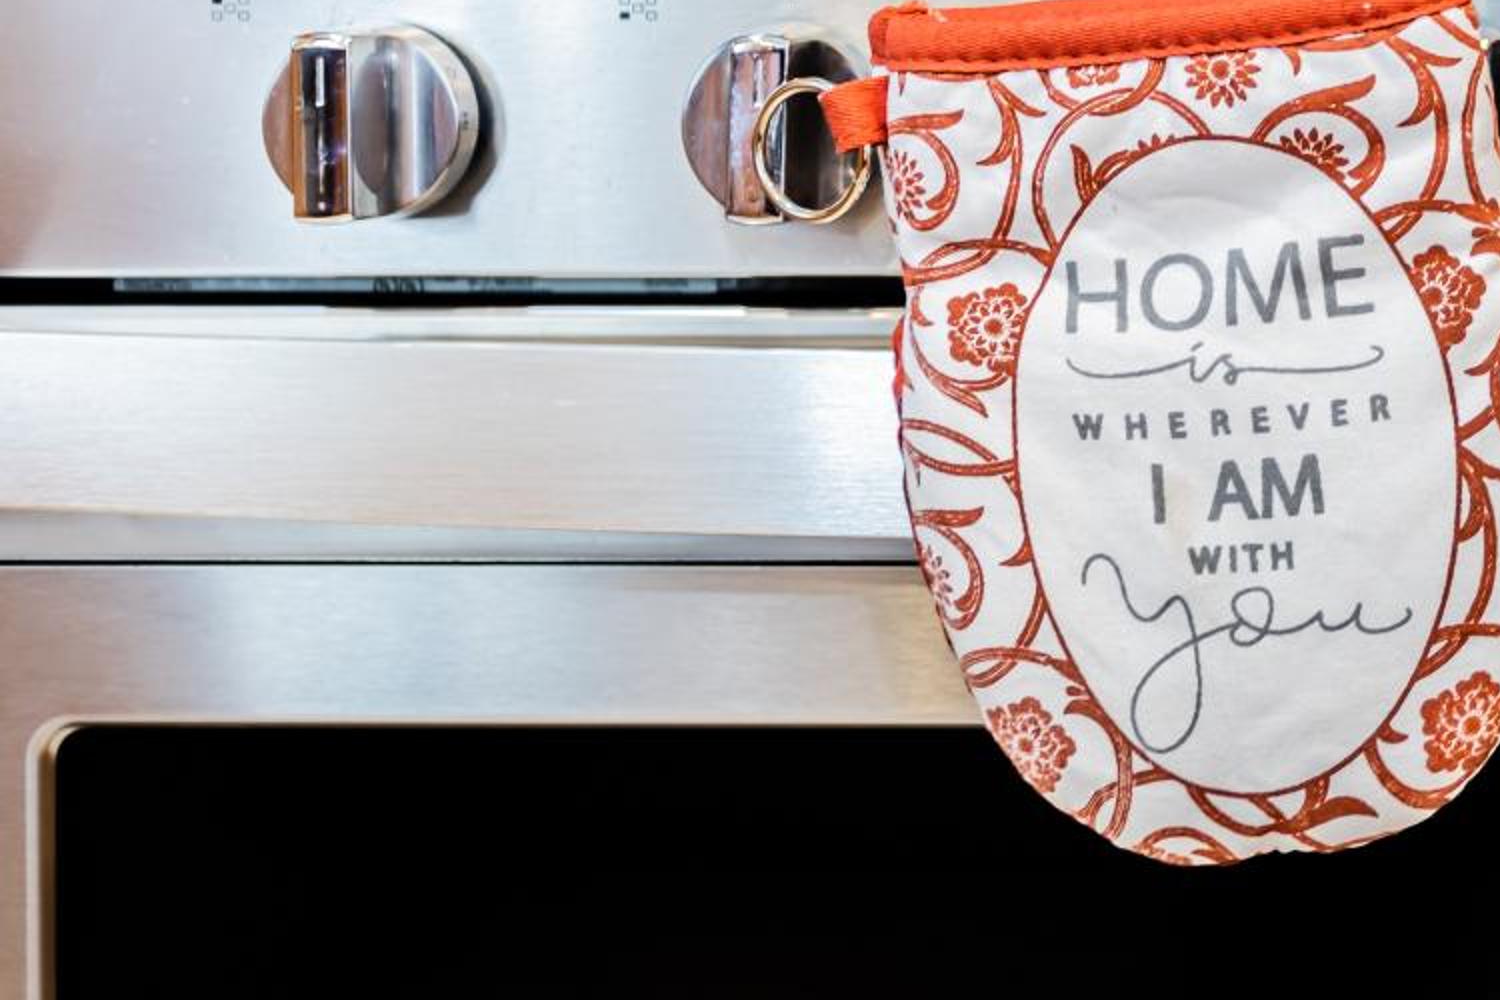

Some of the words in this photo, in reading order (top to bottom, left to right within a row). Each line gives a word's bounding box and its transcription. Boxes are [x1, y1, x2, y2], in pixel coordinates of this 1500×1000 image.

[1065, 234, 1374, 333] HOME
[1073, 394, 1391, 441] WHEREVER
[1151, 463, 1167, 525] I
[1207, 453, 1325, 522] AM
[1188, 541, 1295, 576] WITH
